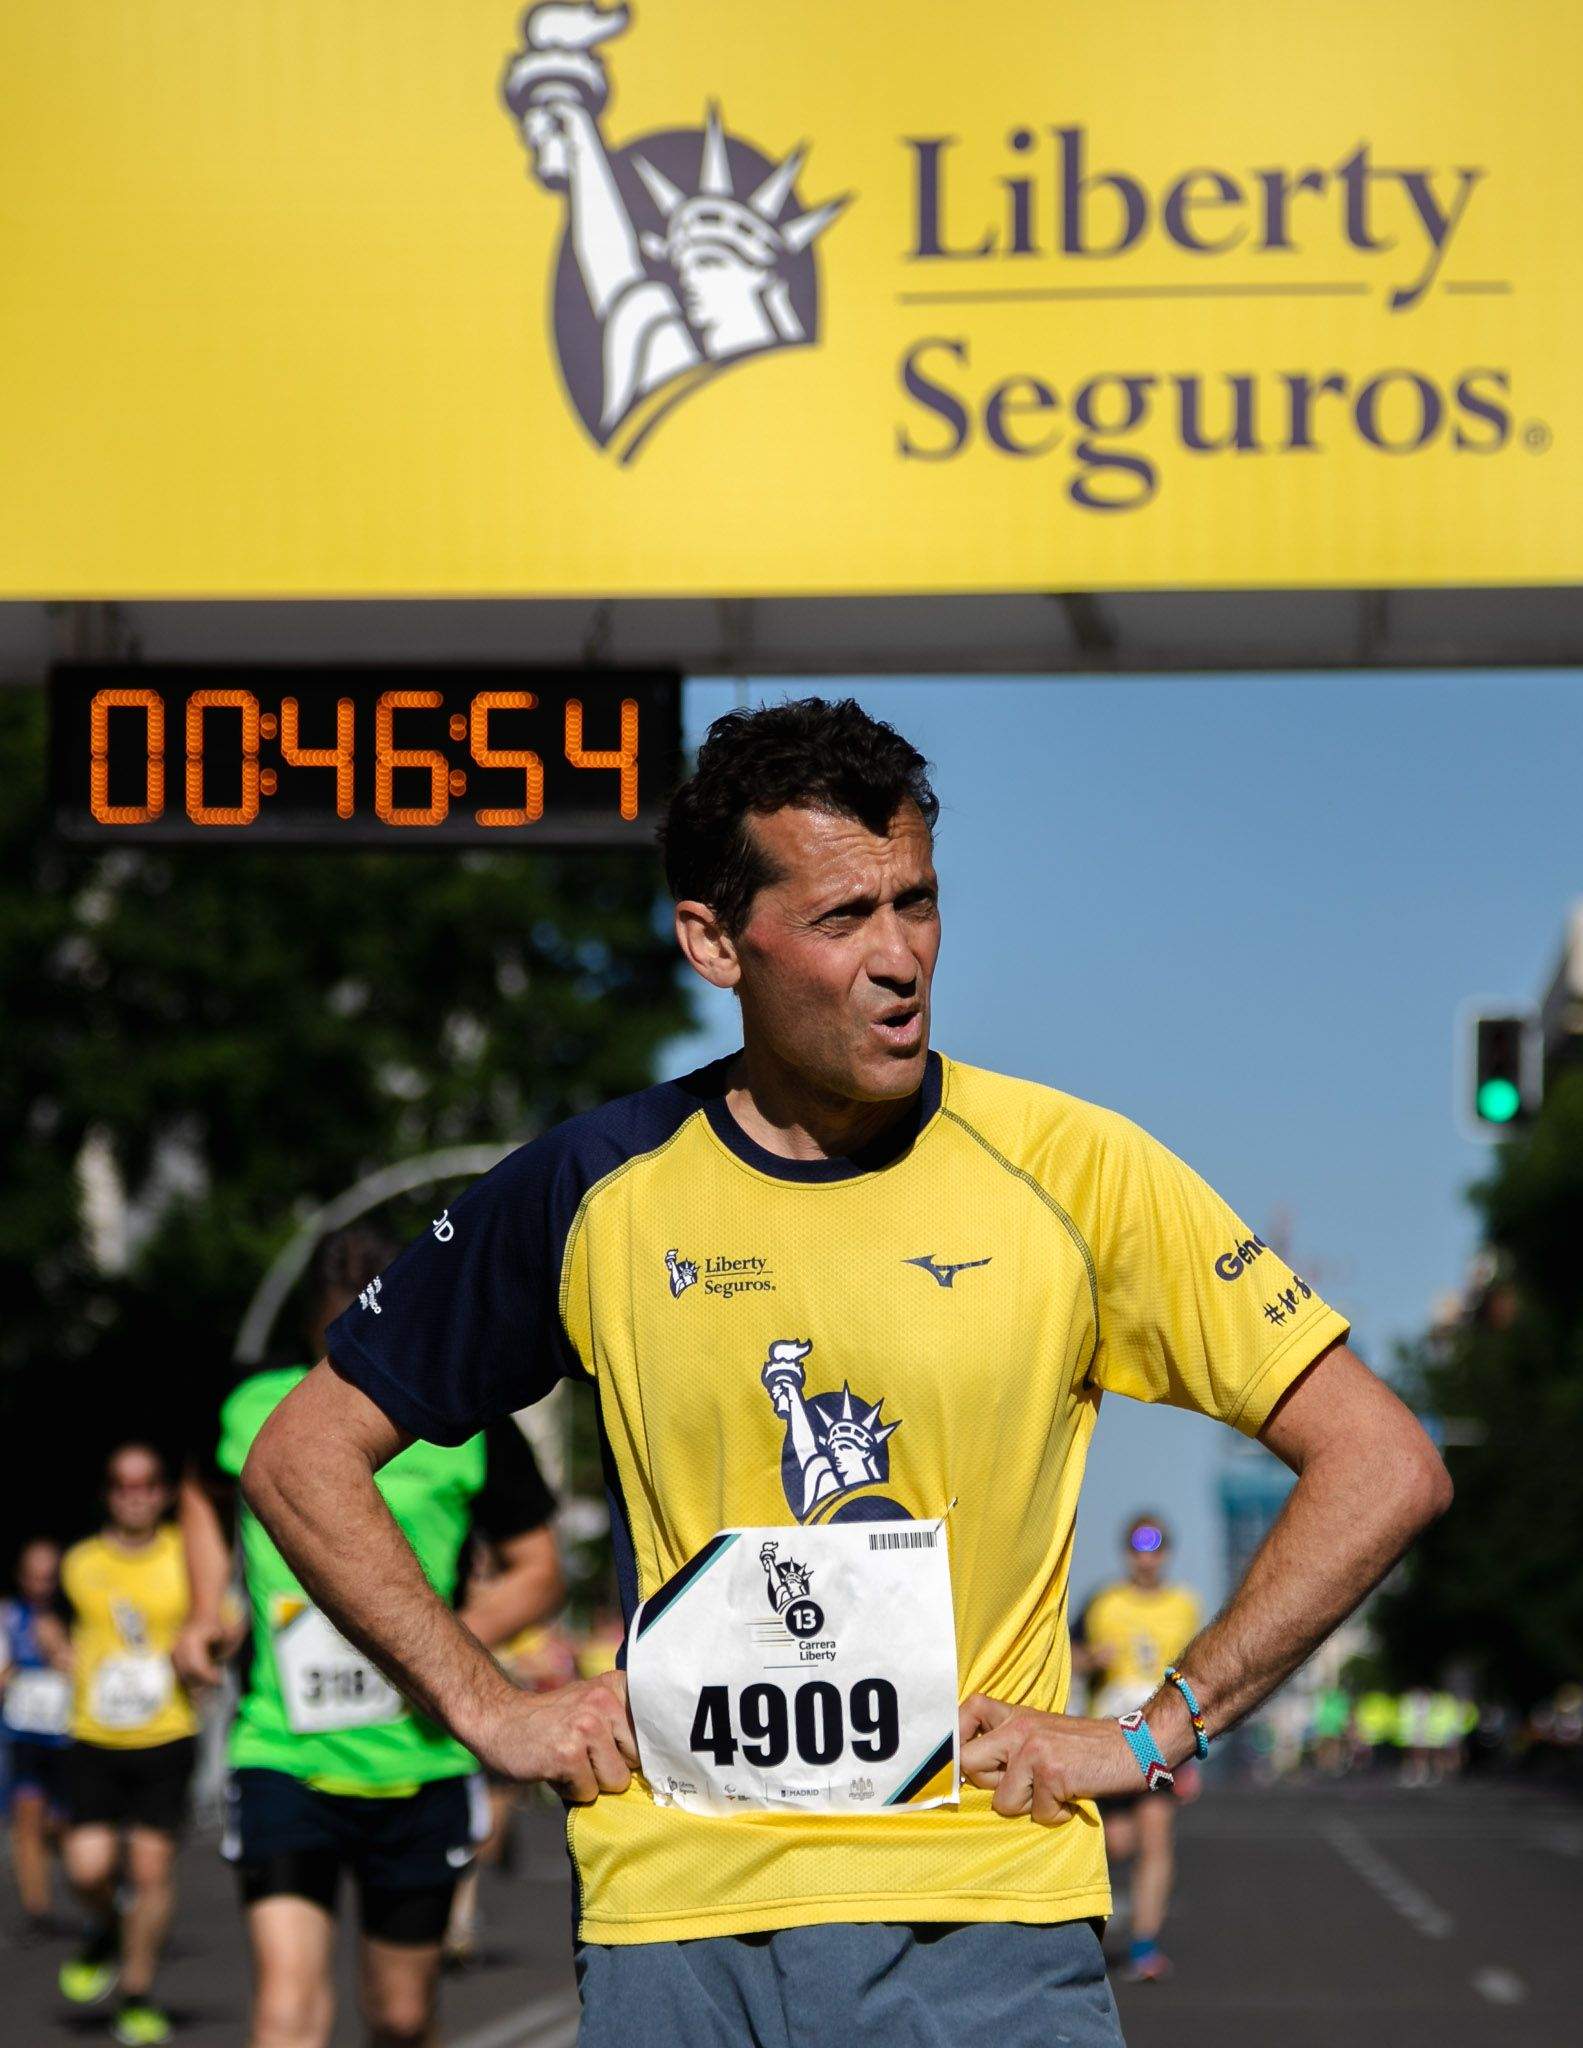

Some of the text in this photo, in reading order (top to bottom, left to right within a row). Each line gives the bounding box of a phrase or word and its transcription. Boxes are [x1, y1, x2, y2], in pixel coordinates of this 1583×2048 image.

[898, 124, 1485, 313] Liberty
[90, 688, 638, 828] 00:46:54
[704, 1255, 767, 1275] Liberty
[792, 1608, 817, 1630] 13
[799, 1640, 836, 1650] Carrera
[800, 1650, 836, 1662] Liberty
[689, 1677, 900, 1769] 4909
[789, 1788, 820, 1797] MADRID
